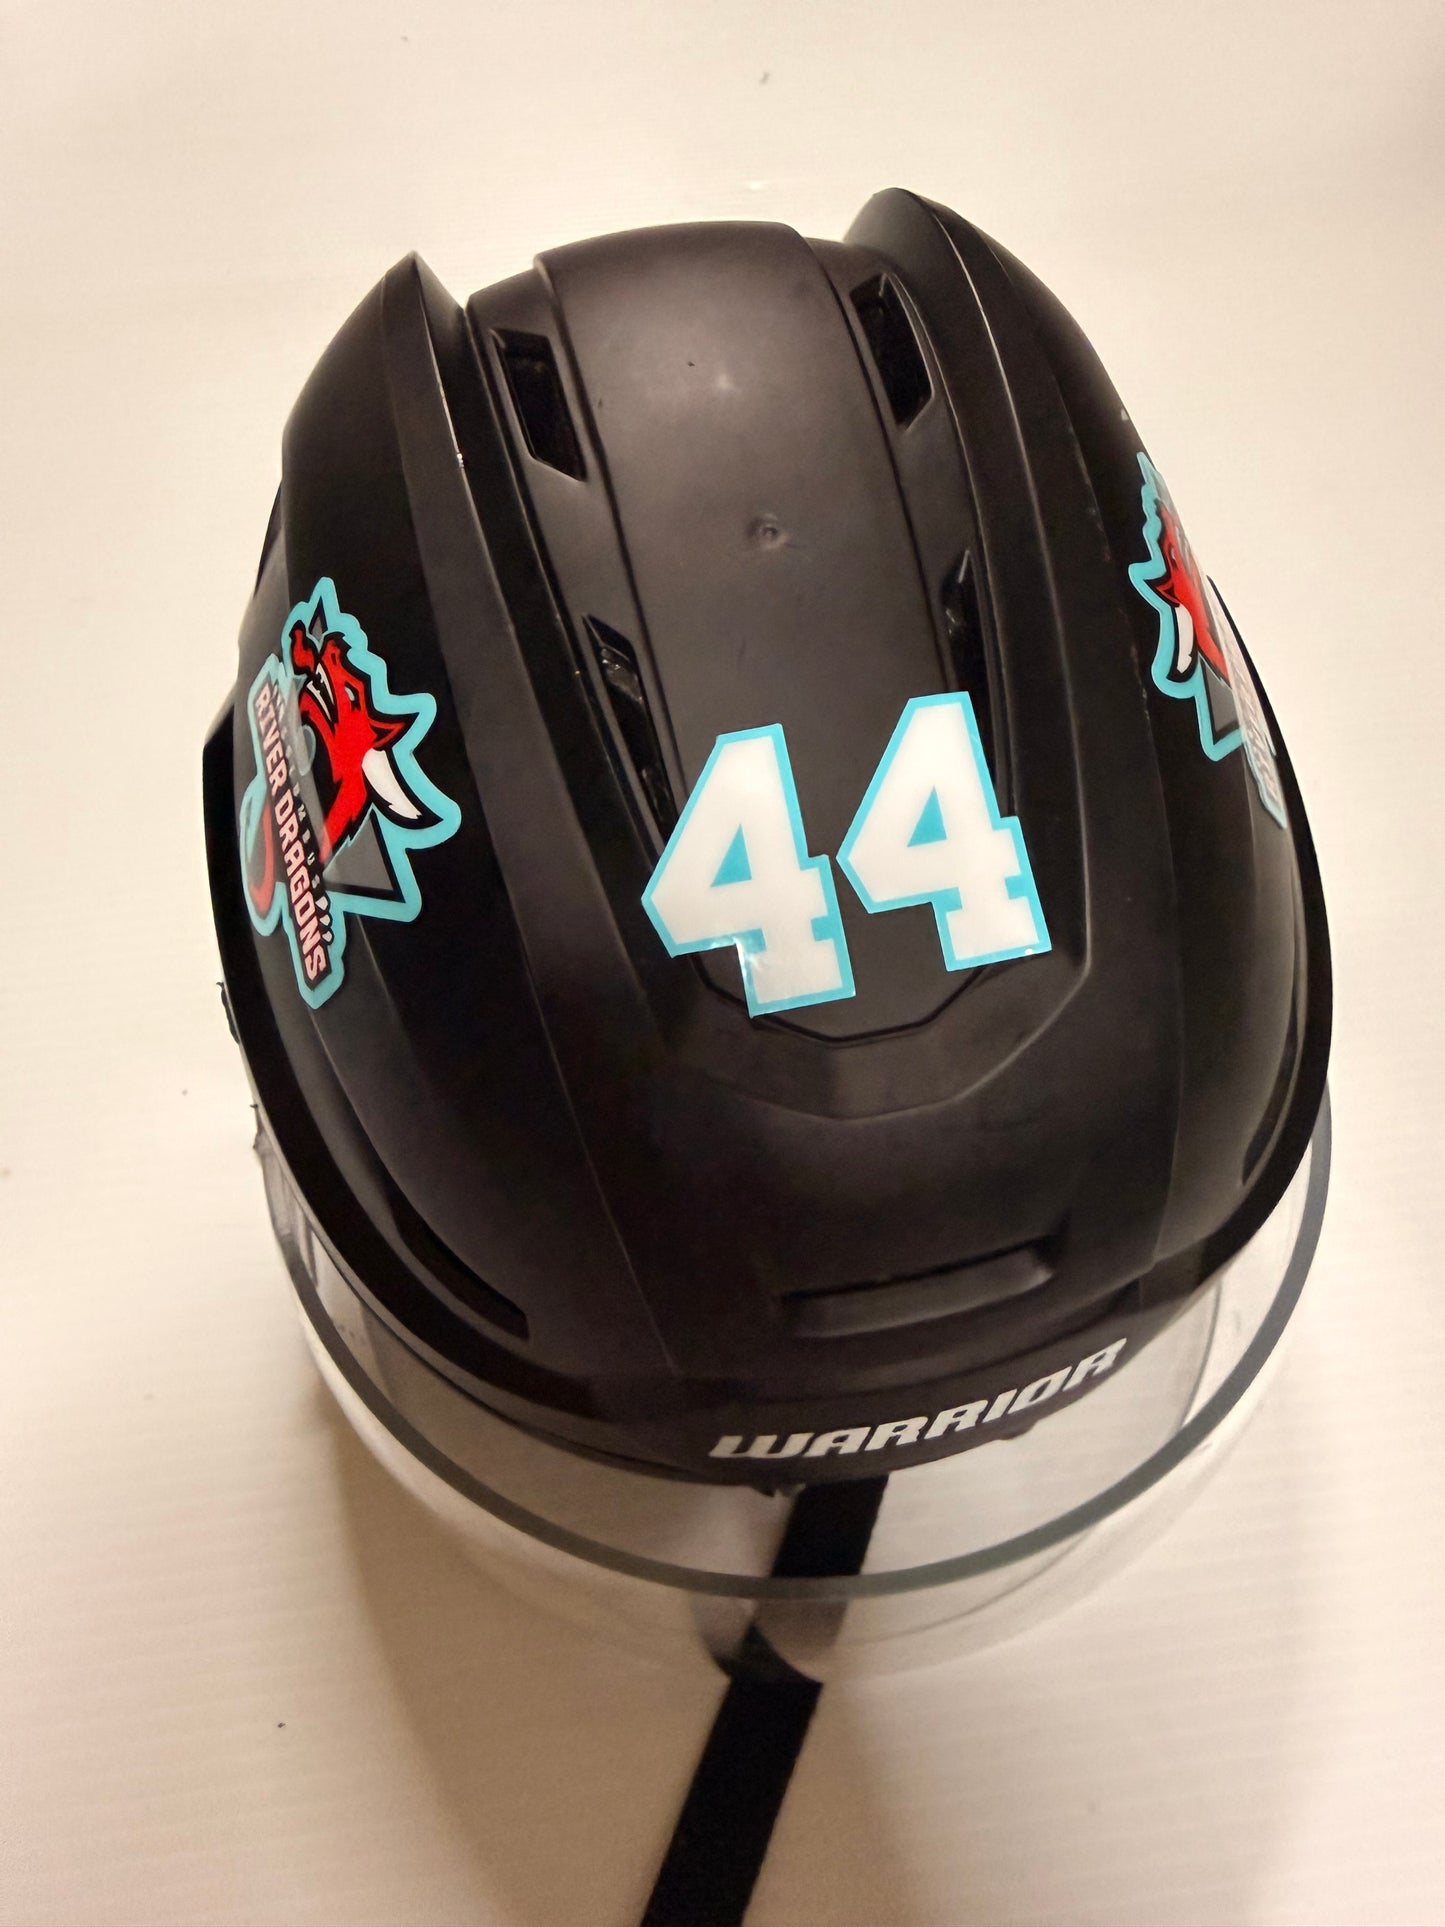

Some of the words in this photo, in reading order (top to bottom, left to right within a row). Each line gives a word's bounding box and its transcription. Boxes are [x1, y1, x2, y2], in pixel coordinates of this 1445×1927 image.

[255, 683, 288, 797] RIVER
[275, 788, 326, 981] DRAGONS
[641, 690, 1052, 1019] 44
[708, 1337, 1127, 1458] WARRIOR
